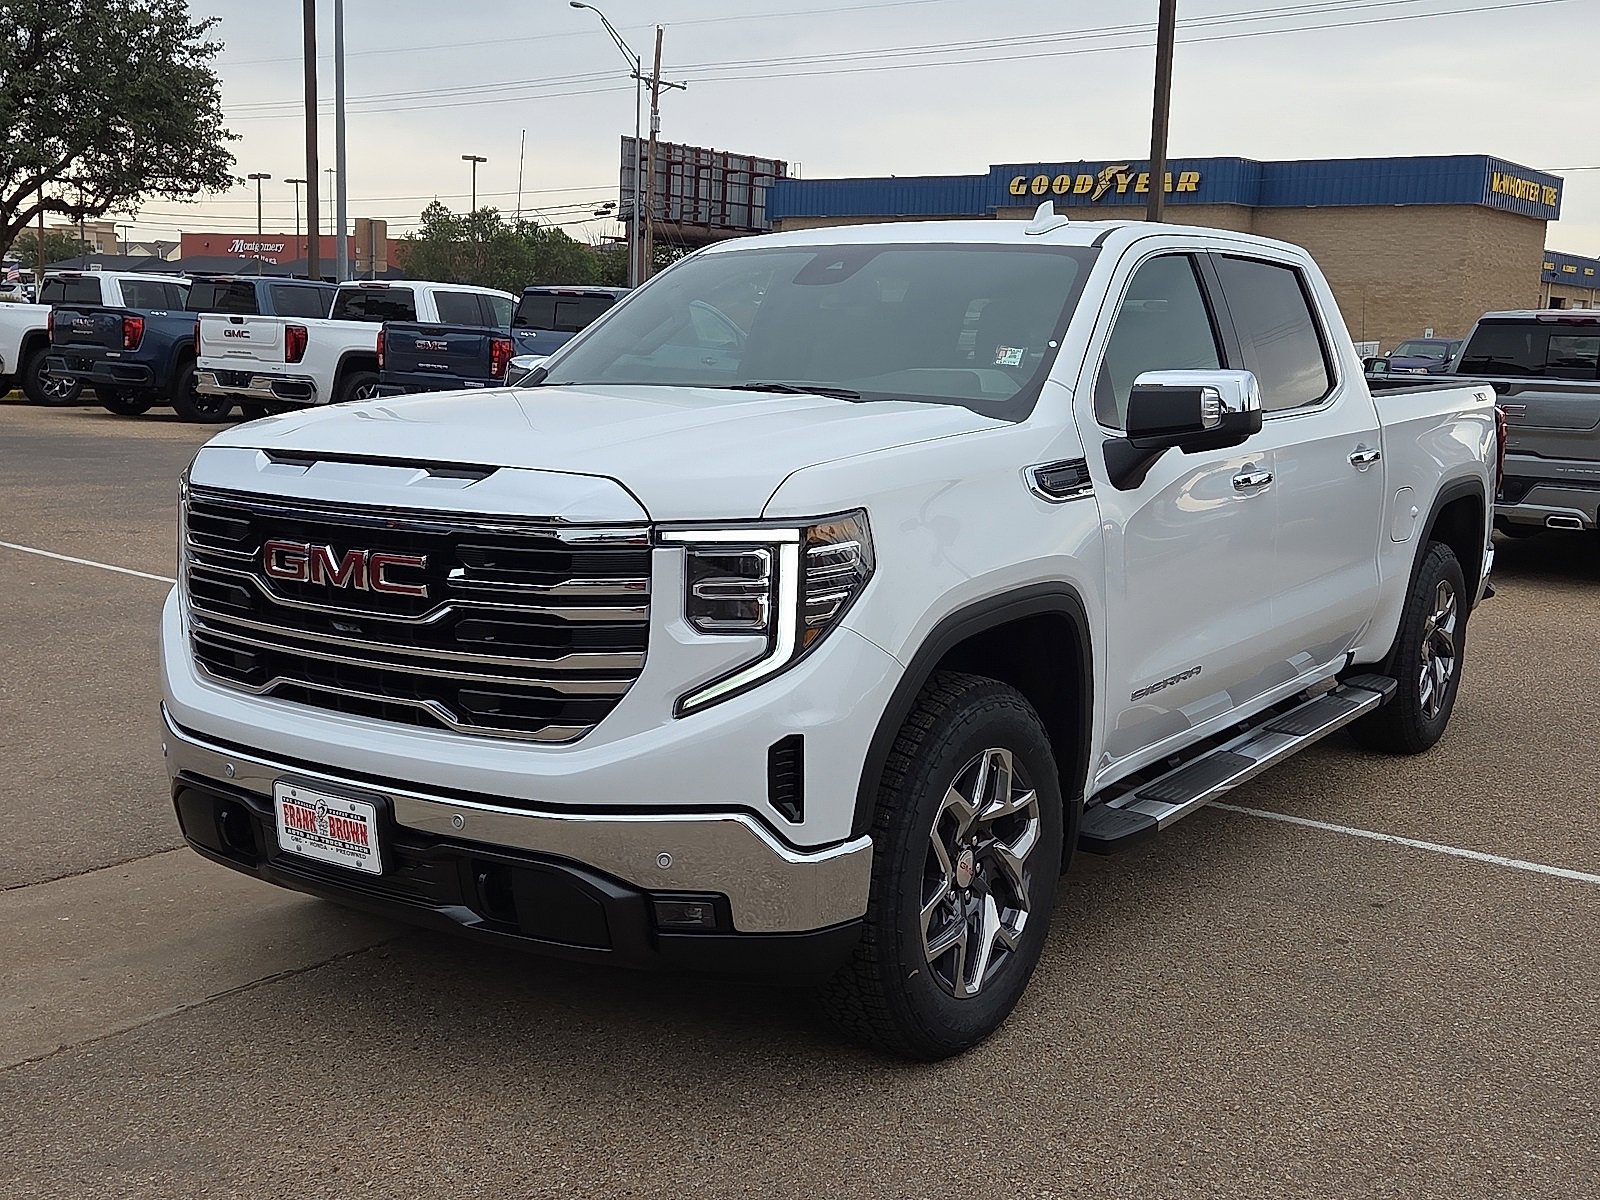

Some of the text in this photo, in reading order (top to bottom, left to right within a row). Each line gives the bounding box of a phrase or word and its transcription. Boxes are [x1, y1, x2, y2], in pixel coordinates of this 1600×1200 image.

[1542, 185, 1558, 206] TIRE
[223, 329, 251, 339] GMC
[264, 540, 429, 598] GMC
[1130, 665, 1202, 702] SIERRA
[283, 804, 368, 845] FRANK BROWN
